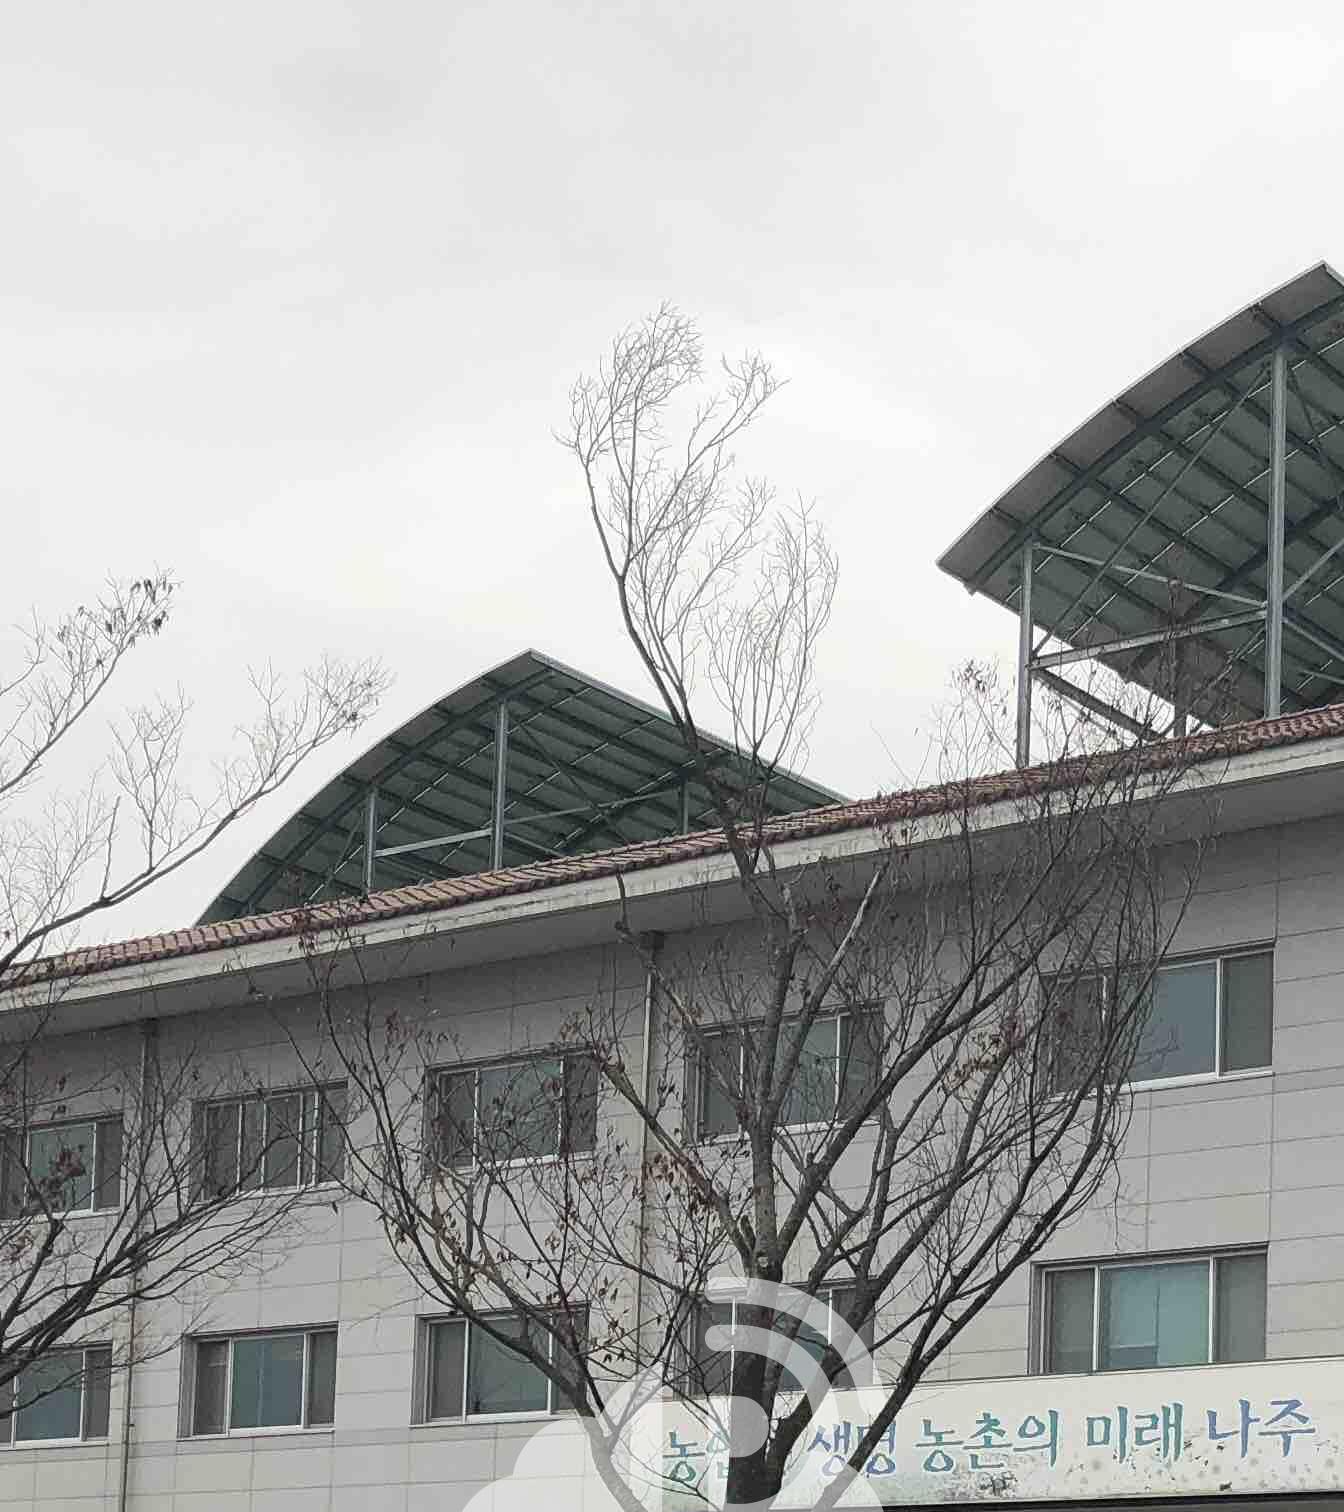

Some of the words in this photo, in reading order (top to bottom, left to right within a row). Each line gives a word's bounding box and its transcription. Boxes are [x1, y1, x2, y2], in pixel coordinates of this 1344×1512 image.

[914, 1409, 1059, 1473] 농촌의
[1085, 1402, 1184, 1464] 미래
[1206, 1398, 1317, 1459] 나주
